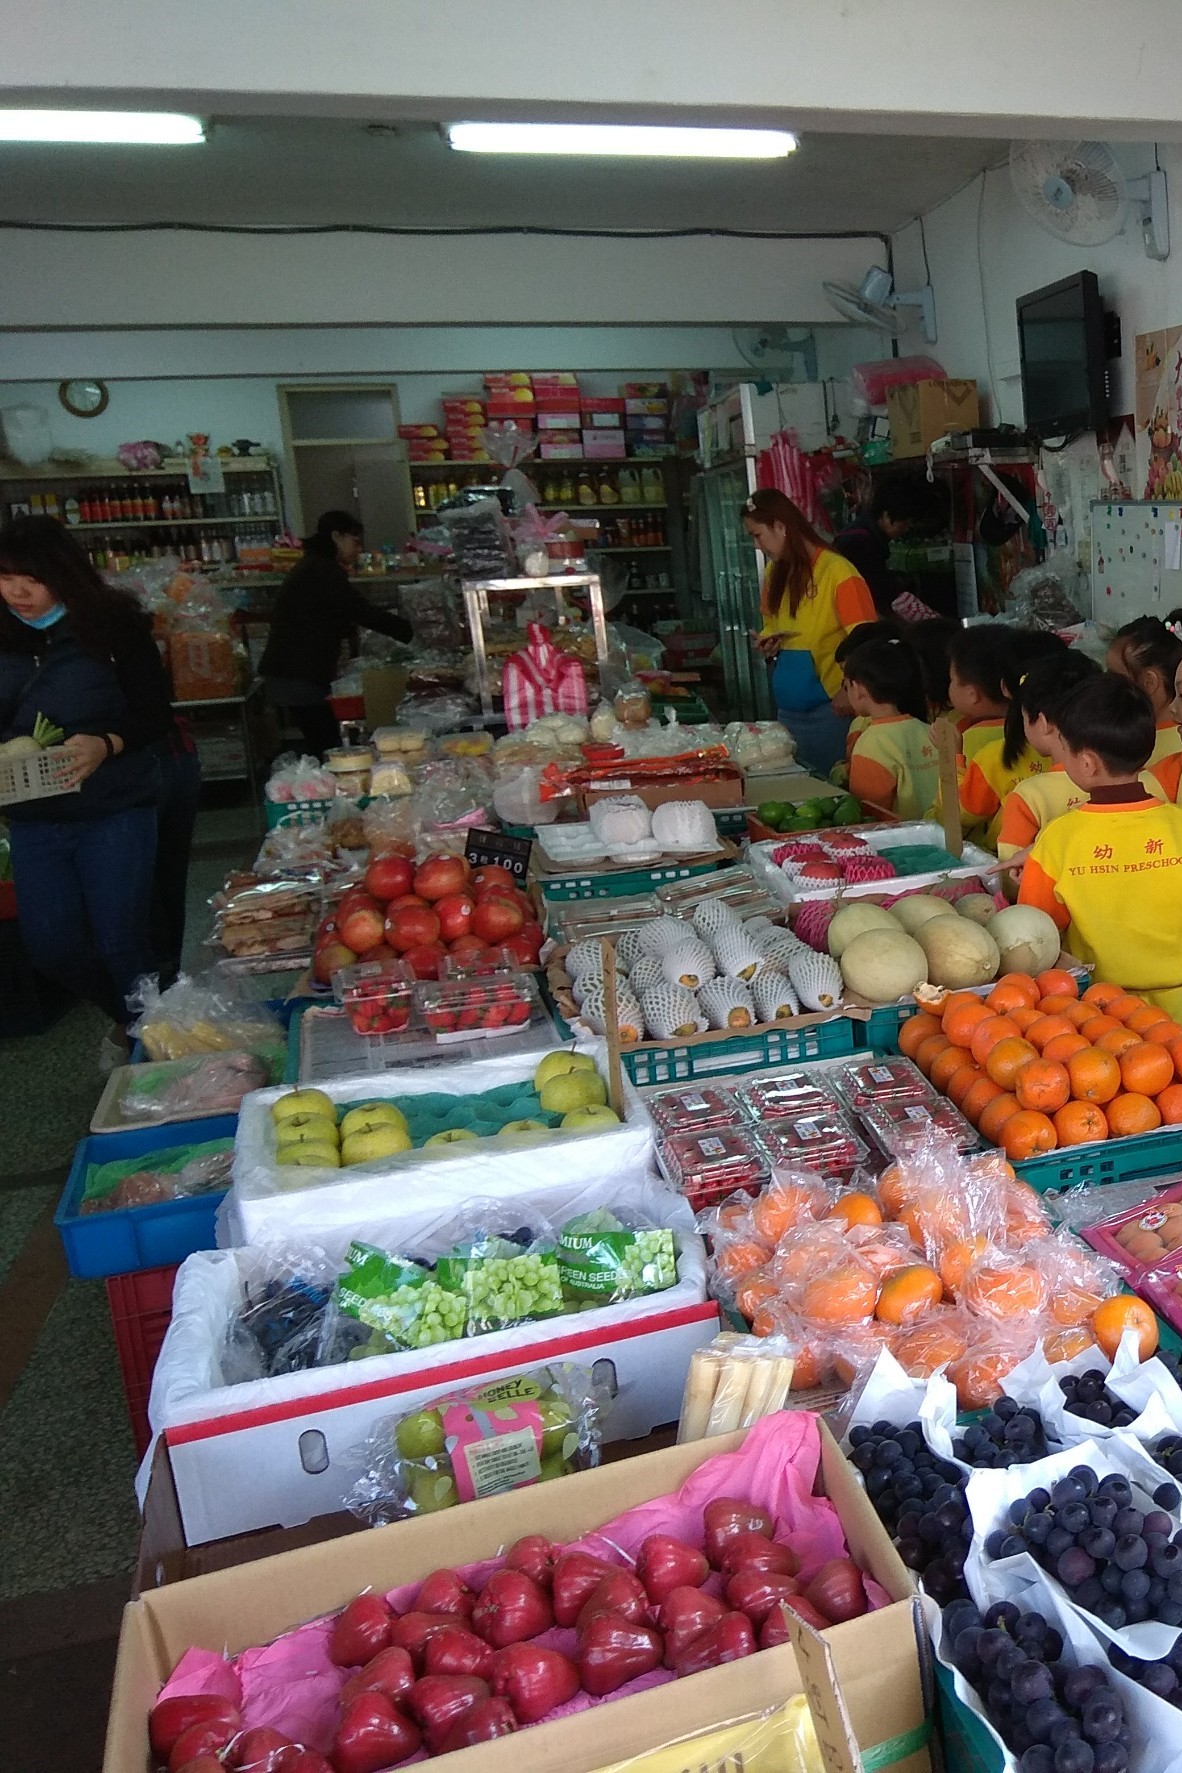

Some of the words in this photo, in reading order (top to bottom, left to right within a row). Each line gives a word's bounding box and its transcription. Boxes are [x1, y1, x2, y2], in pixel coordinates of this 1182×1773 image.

[1093, 844, 1113, 861] 幼
[1144, 838, 1164, 856] 新
[1068, 866, 1086, 876] YU
[1090, 864, 1120, 874] HSIN
[569, 1280, 605, 1289] AUSTRALIA
